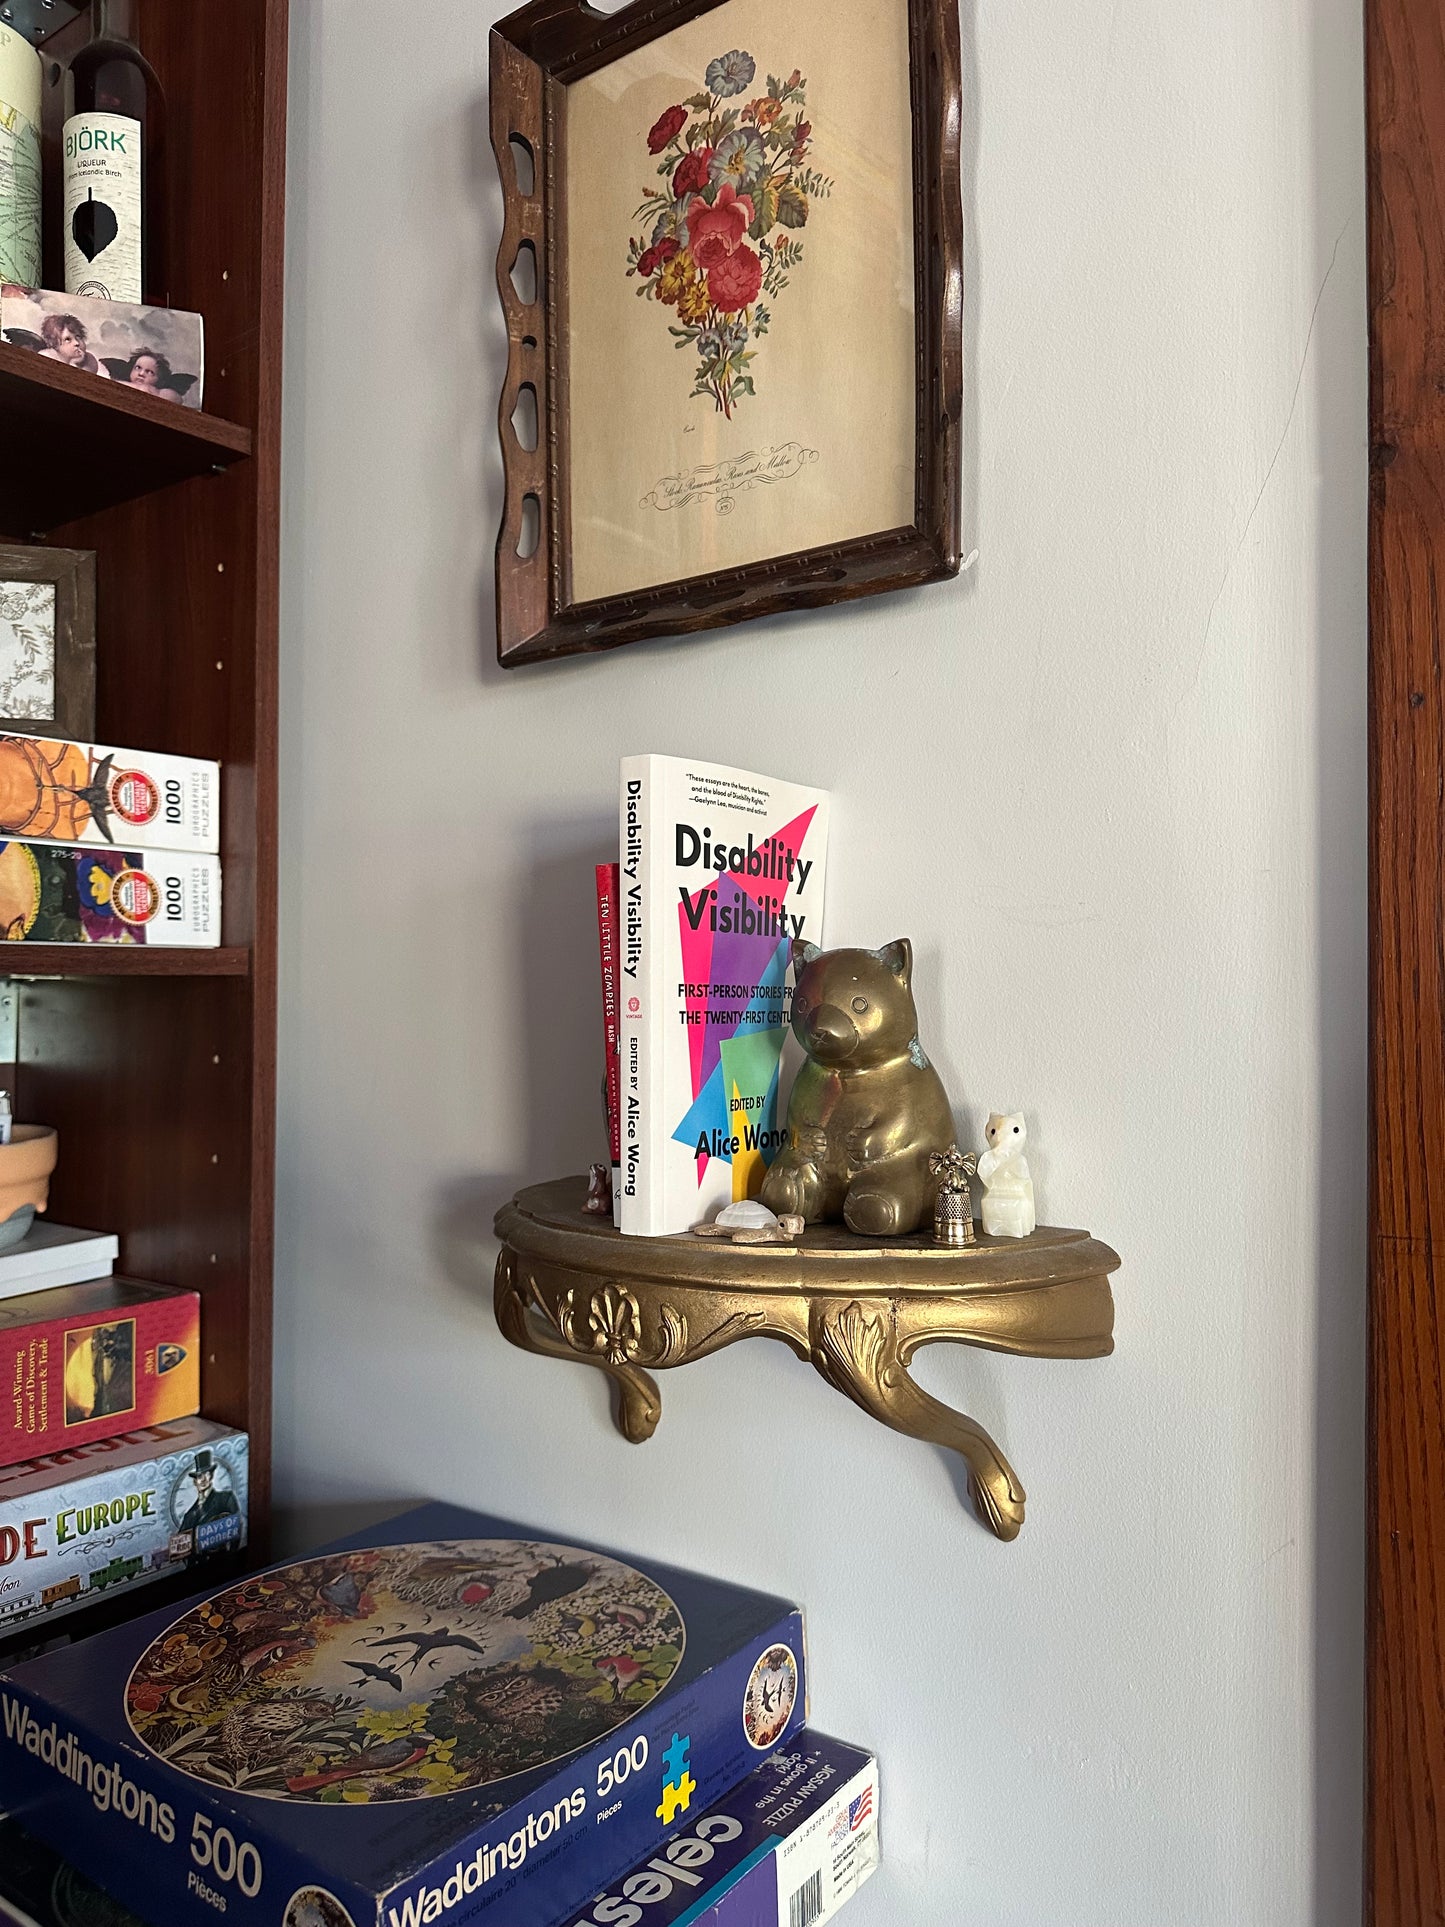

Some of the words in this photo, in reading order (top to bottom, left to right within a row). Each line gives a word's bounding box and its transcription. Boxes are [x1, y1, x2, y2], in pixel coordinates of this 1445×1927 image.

[66, 126, 126, 158] BJÖRK
[105, 169, 122, 178] Birch
[112, 776, 124, 816] MUSEUM
[166, 779, 181, 824] 1000
[703, 786, 712, 794] the
[712, 788, 726, 797] blood
[732, 792, 751, 804] Disability
[705, 778, 722, 786] essays
[722, 780, 730, 788] are
[738, 783, 751, 792] heart,
[758, 788, 770, 797] bones,
[202, 773, 210, 838] PUZZLES
[717, 799, 728, 808] Lea,
[728, 803, 746, 811] musician
[746, 806, 754, 814] and
[754, 808, 768, 816] activist
[624, 780, 642, 880] Disability
[676, 823, 813, 895] Disability
[112, 876, 124, 916] MUSEUM
[166, 876, 182, 921] 1000
[202, 868, 210, 933] PUZZLES
[600, 894, 609, 918] TEN
[678, 886, 806, 939] Visibility
[602, 922, 612, 962] LITTLE
[624, 884, 642, 978] Visibility
[678, 984, 749, 998] FIRST-PERSON
[750, 986, 782, 999] STORIES
[679, 1011, 701, 1025] THE
[705, 1010, 765, 1025] TWENTY-FIRST
[630, 1037, 638, 1074] EDITED
[630, 1077, 638, 1091] BY
[628, 1096, 640, 1139] Alice
[730, 1097, 754, 1112] EDITED
[756, 1096, 766, 1108] BY
[694, 1128, 740, 1160] Alice
[624, 1144, 640, 1196] Wong
[39, 1338, 48, 1366] Trade
[40, 1368, 48, 1378] &
[13, 1350, 26, 1429] Award-Winning
[26, 1391, 35, 1402] of
[26, 1404, 36, 1434] Game
[39, 1380, 48, 1432] Settlement
[56, 1490, 157, 1546] EUROPE
[200, 1520, 224, 1537] DAYS
[226, 1516, 239, 1528] OF
[776, 1752, 802, 1774] dark!
[780, 1763, 808, 1786] glows
[2, 1693, 176, 1844] Waddingtons
[190, 1811, 263, 1898] 500
[770, 1786, 786, 1794] in
[796, 1764, 836, 1798] JIGSAW
[596, 1799, 622, 1825] Pièces
[756, 1794, 776, 1808] the
[762, 1797, 804, 1827] PUZZLE
[388, 1787, 586, 1927] Waddingtons
[596, 1734, 650, 1798] 500
[574, 1826, 588, 1842] cm
[188, 1870, 227, 1913] Pièces
